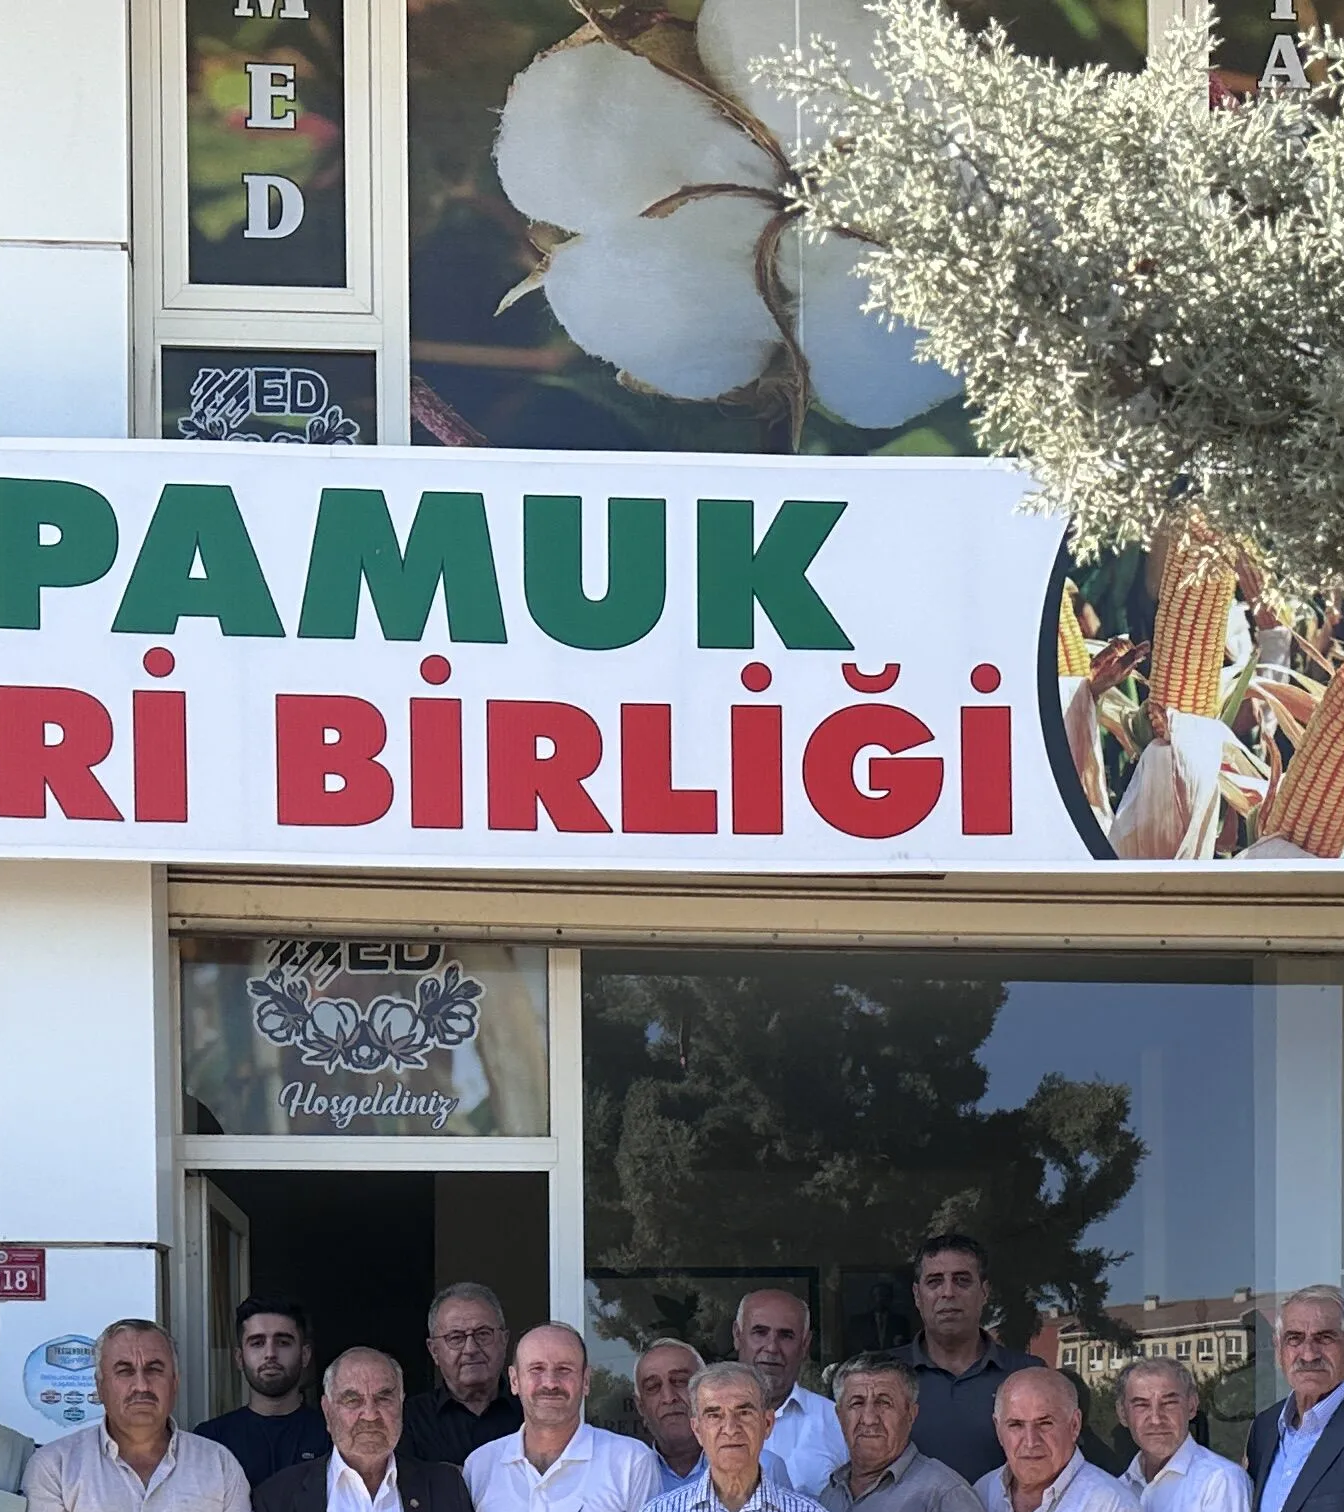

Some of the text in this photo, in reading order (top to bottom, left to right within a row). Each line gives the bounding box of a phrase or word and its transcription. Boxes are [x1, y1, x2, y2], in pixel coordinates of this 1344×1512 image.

[233, 0, 310, 239] ED
[276, 654, 1012, 839] BİRLİĞİ
[279, 1081, 460, 1130] Hoşgeldiniz
